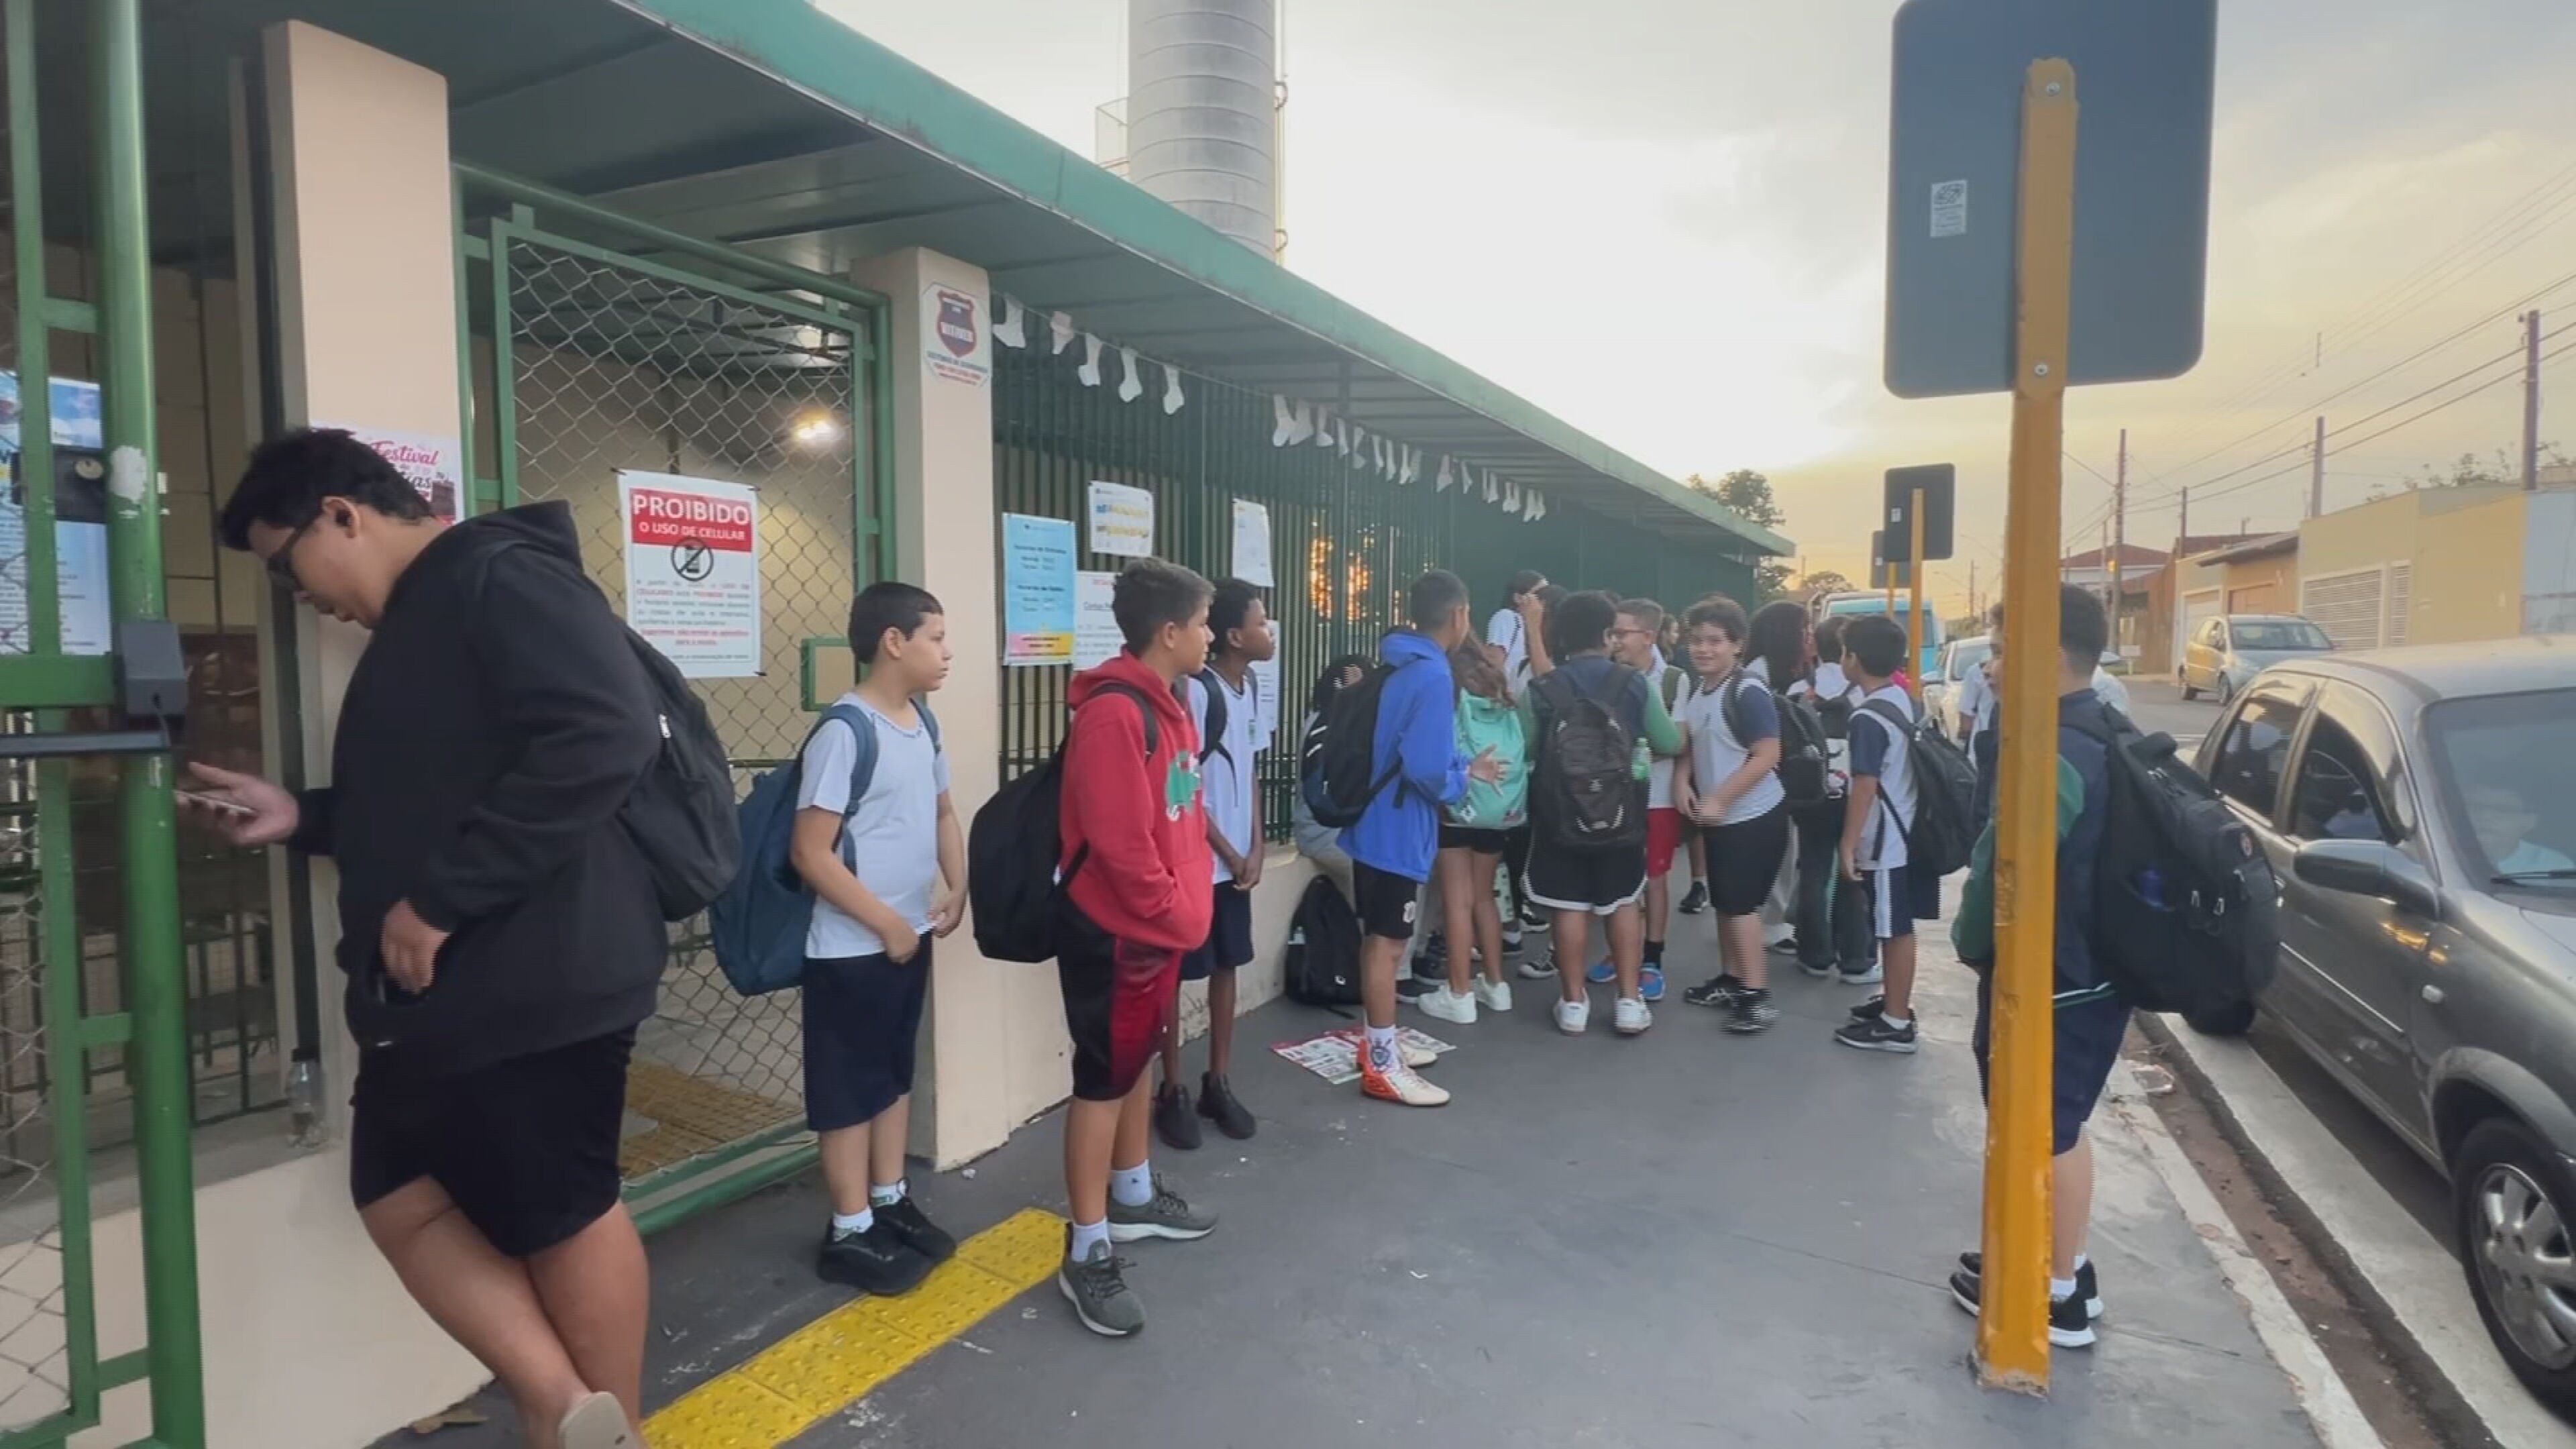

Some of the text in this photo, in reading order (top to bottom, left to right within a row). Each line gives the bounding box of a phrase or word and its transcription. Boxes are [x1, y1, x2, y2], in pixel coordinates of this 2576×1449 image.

[633, 494, 750, 525] PROIBIDO
[639, 521, 745, 540] O USO DE CELULAR
